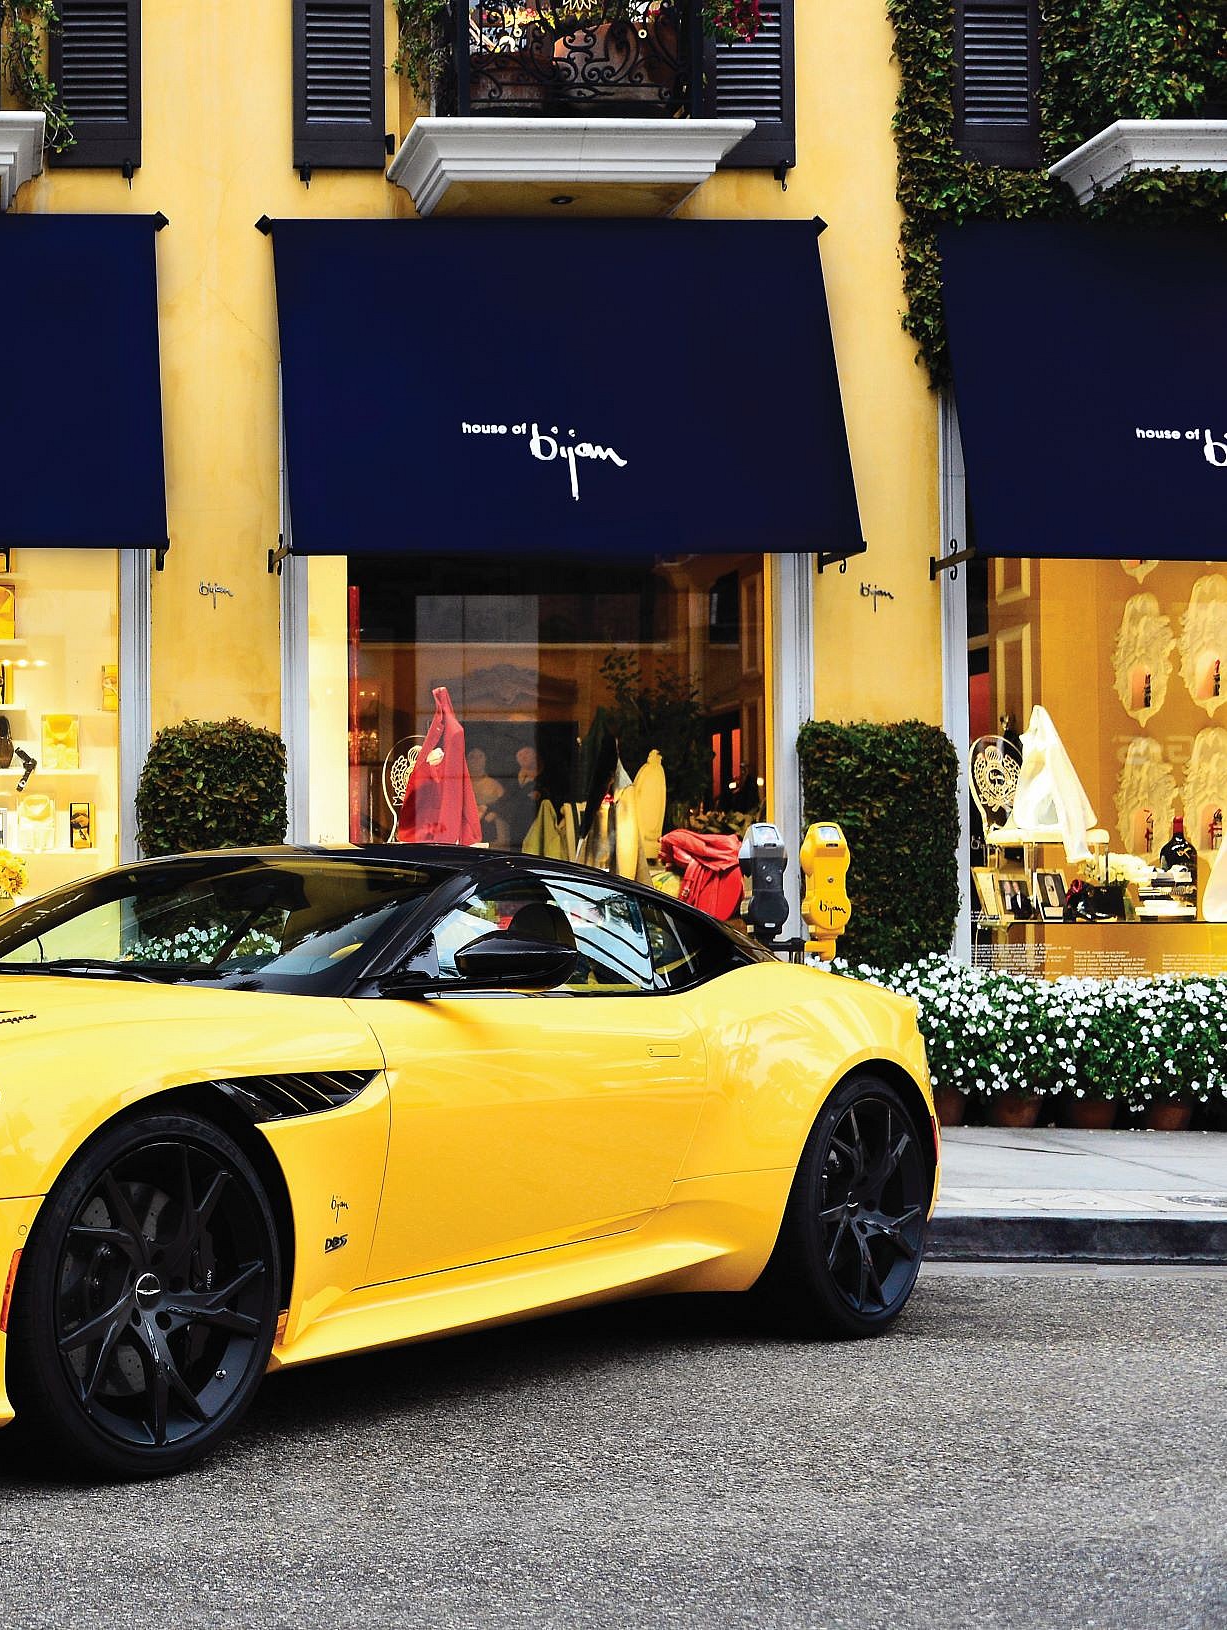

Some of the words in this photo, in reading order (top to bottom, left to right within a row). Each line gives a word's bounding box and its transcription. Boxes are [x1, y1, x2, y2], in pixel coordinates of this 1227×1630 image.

[1135, 427, 1181, 439] house
[1185, 428, 1200, 440] of
[462, 422, 508, 434] house
[512, 423, 527, 434] of
[529, 423, 628, 501] bijan
[198, 579, 234, 610] bijan
[860, 582, 894, 613] bijan
[819, 900, 846, 926] bijan
